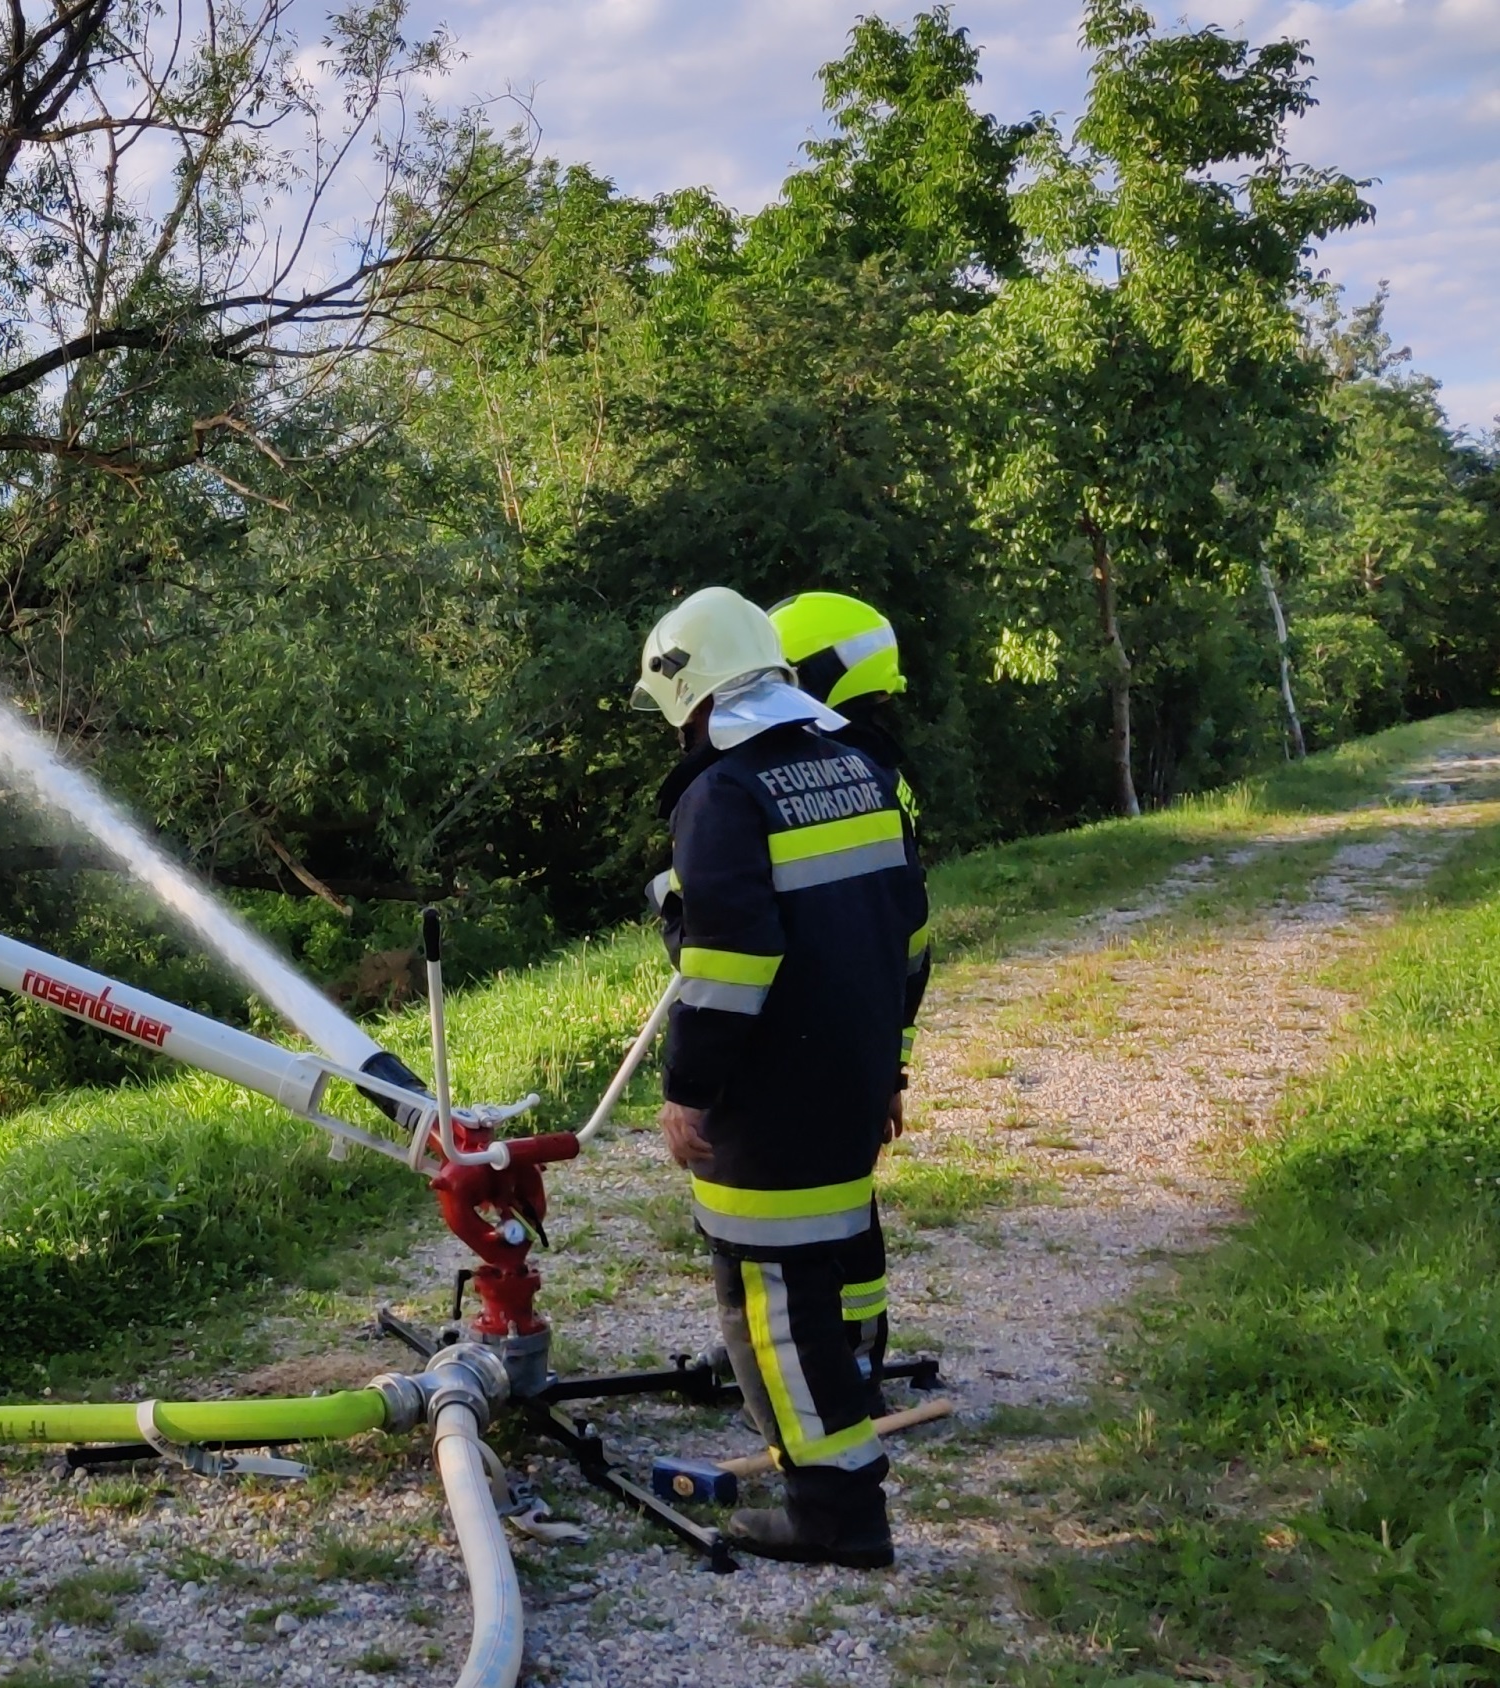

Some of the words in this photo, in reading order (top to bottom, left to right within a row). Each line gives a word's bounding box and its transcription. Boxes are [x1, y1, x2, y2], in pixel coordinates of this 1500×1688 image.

[756, 754, 873, 796] FEUERWEHR
[776, 782, 883, 826] FROHSDORF
[22, 969, 172, 1047] rosenbauer
[27, 1420, 47, 1440] FF
